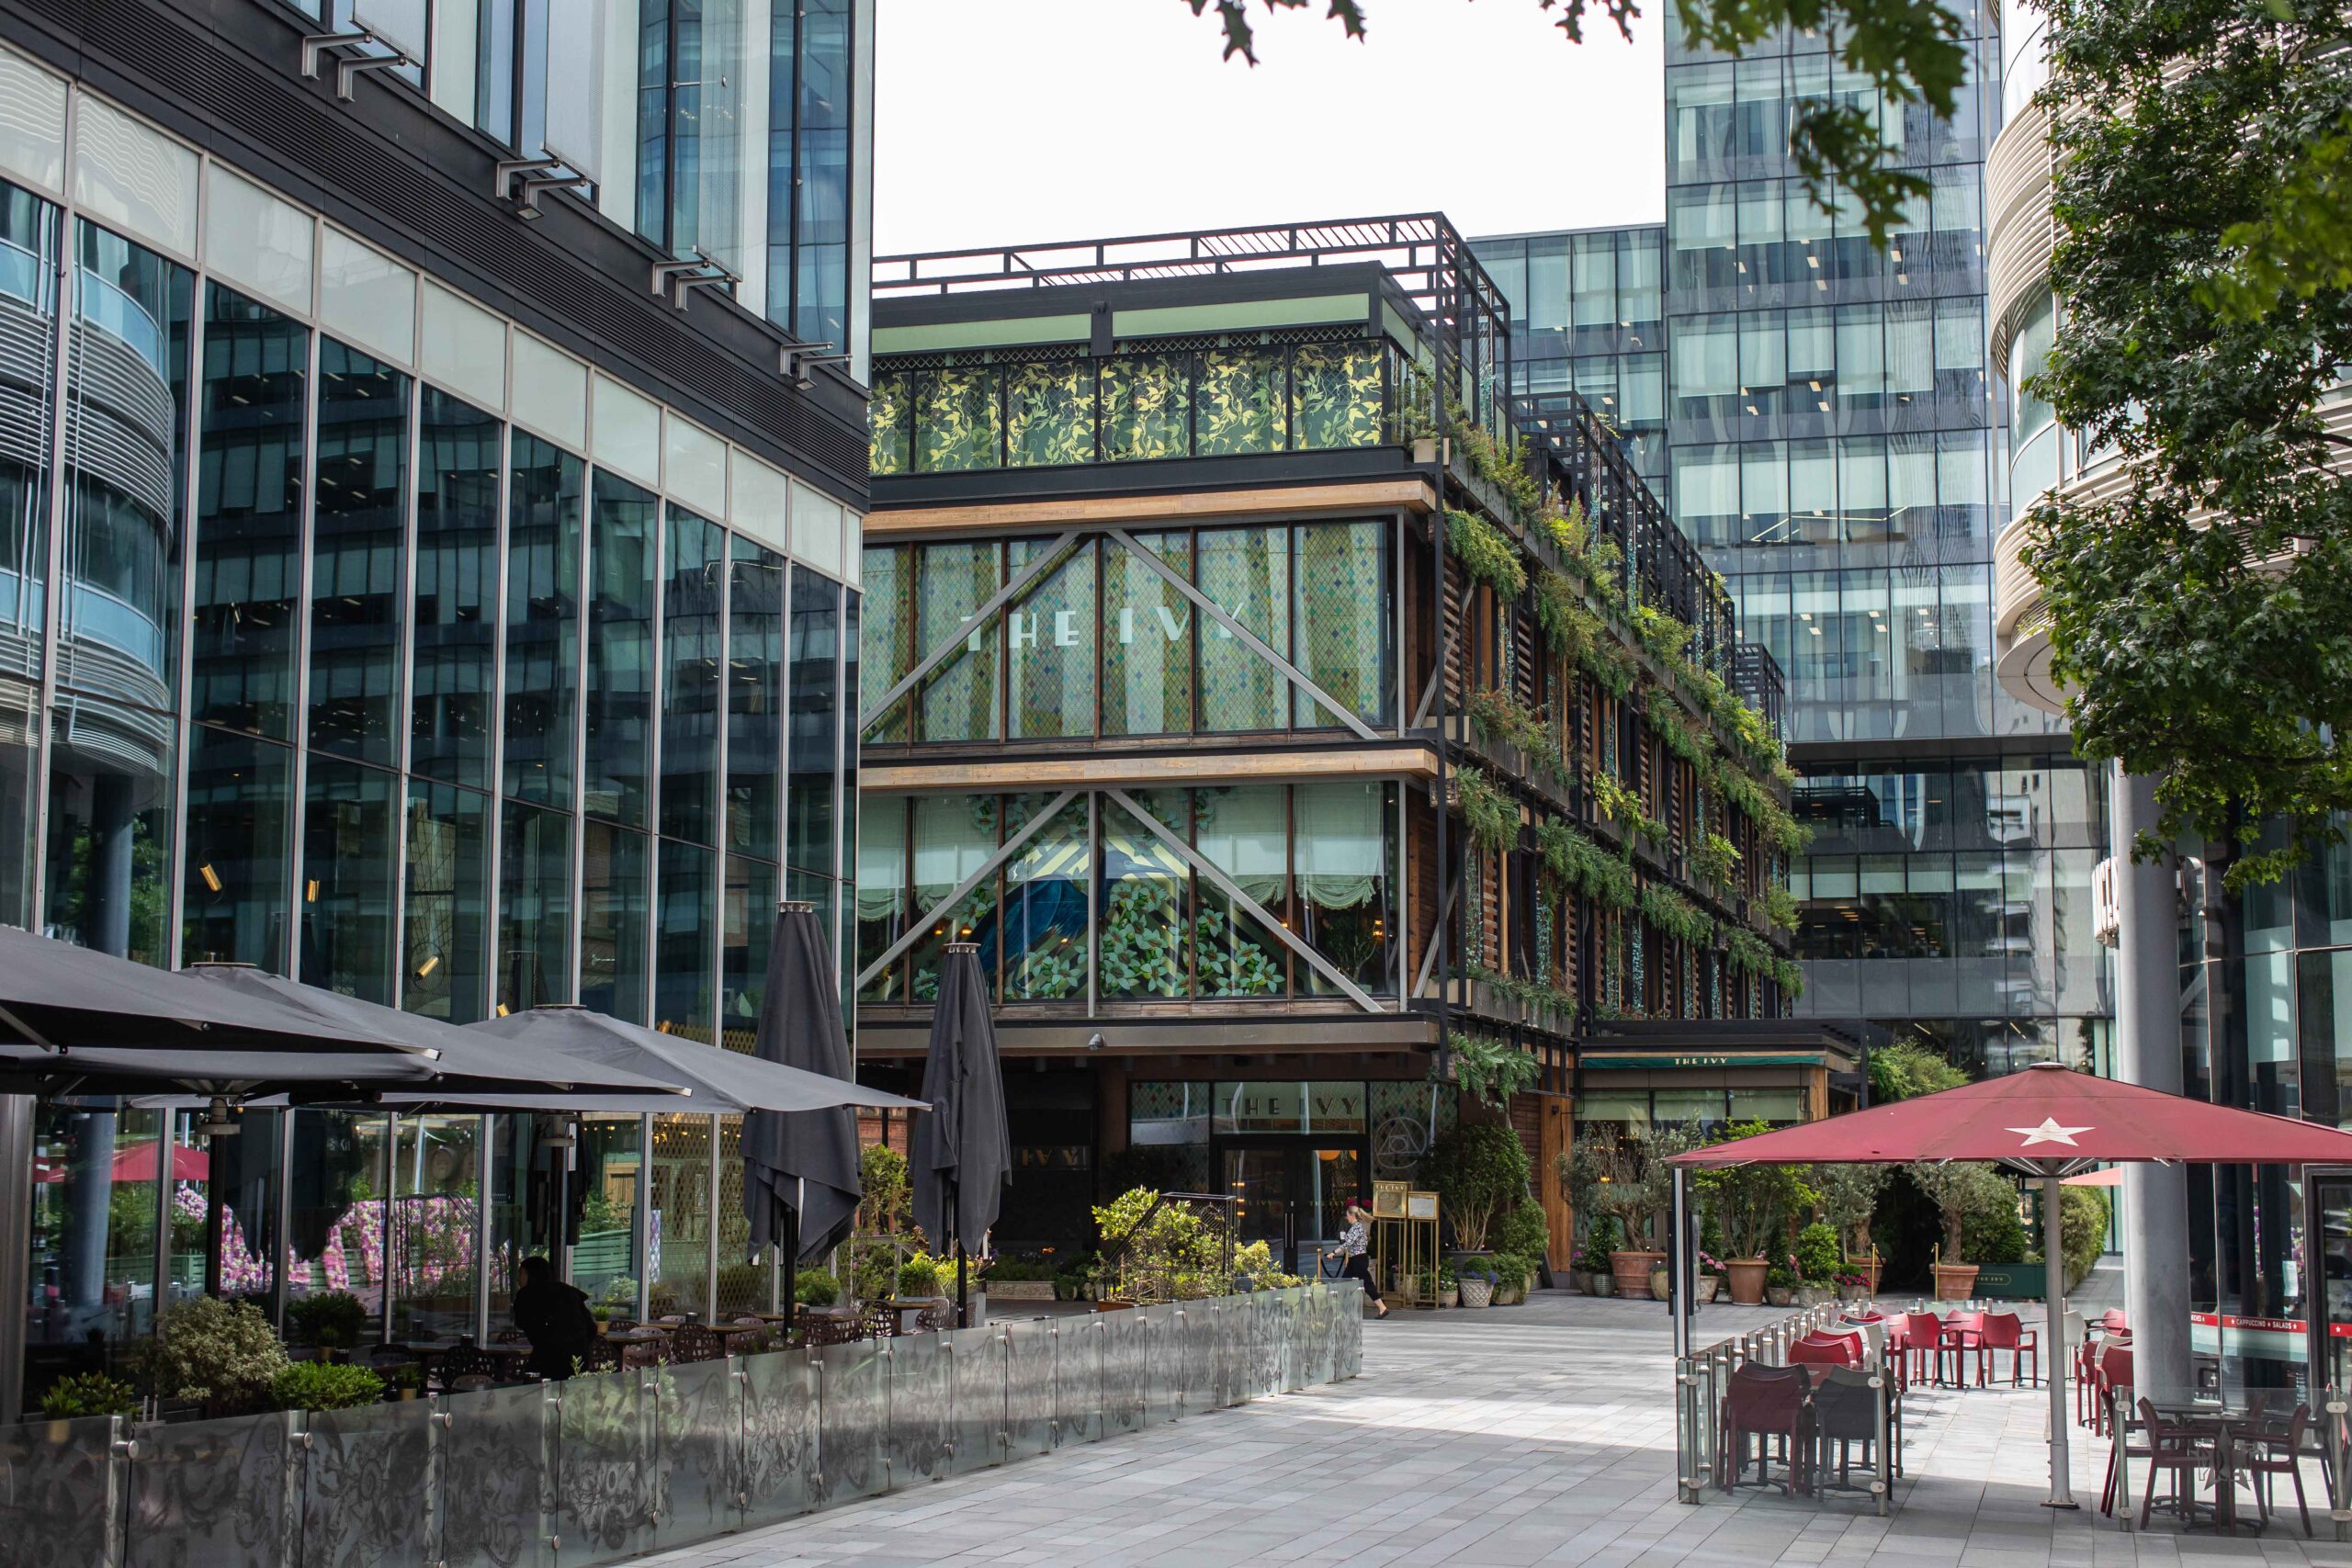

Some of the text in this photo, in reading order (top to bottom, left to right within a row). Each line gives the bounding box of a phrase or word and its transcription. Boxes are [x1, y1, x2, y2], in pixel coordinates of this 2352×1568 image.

[960, 603, 1244, 651] THE IVY
[1222, 1098, 1358, 1115] THE IVY
[1021, 1146, 1080, 1168] IVY
[2236, 1318, 2291, 1329] CAPPUCCINO SALADS
